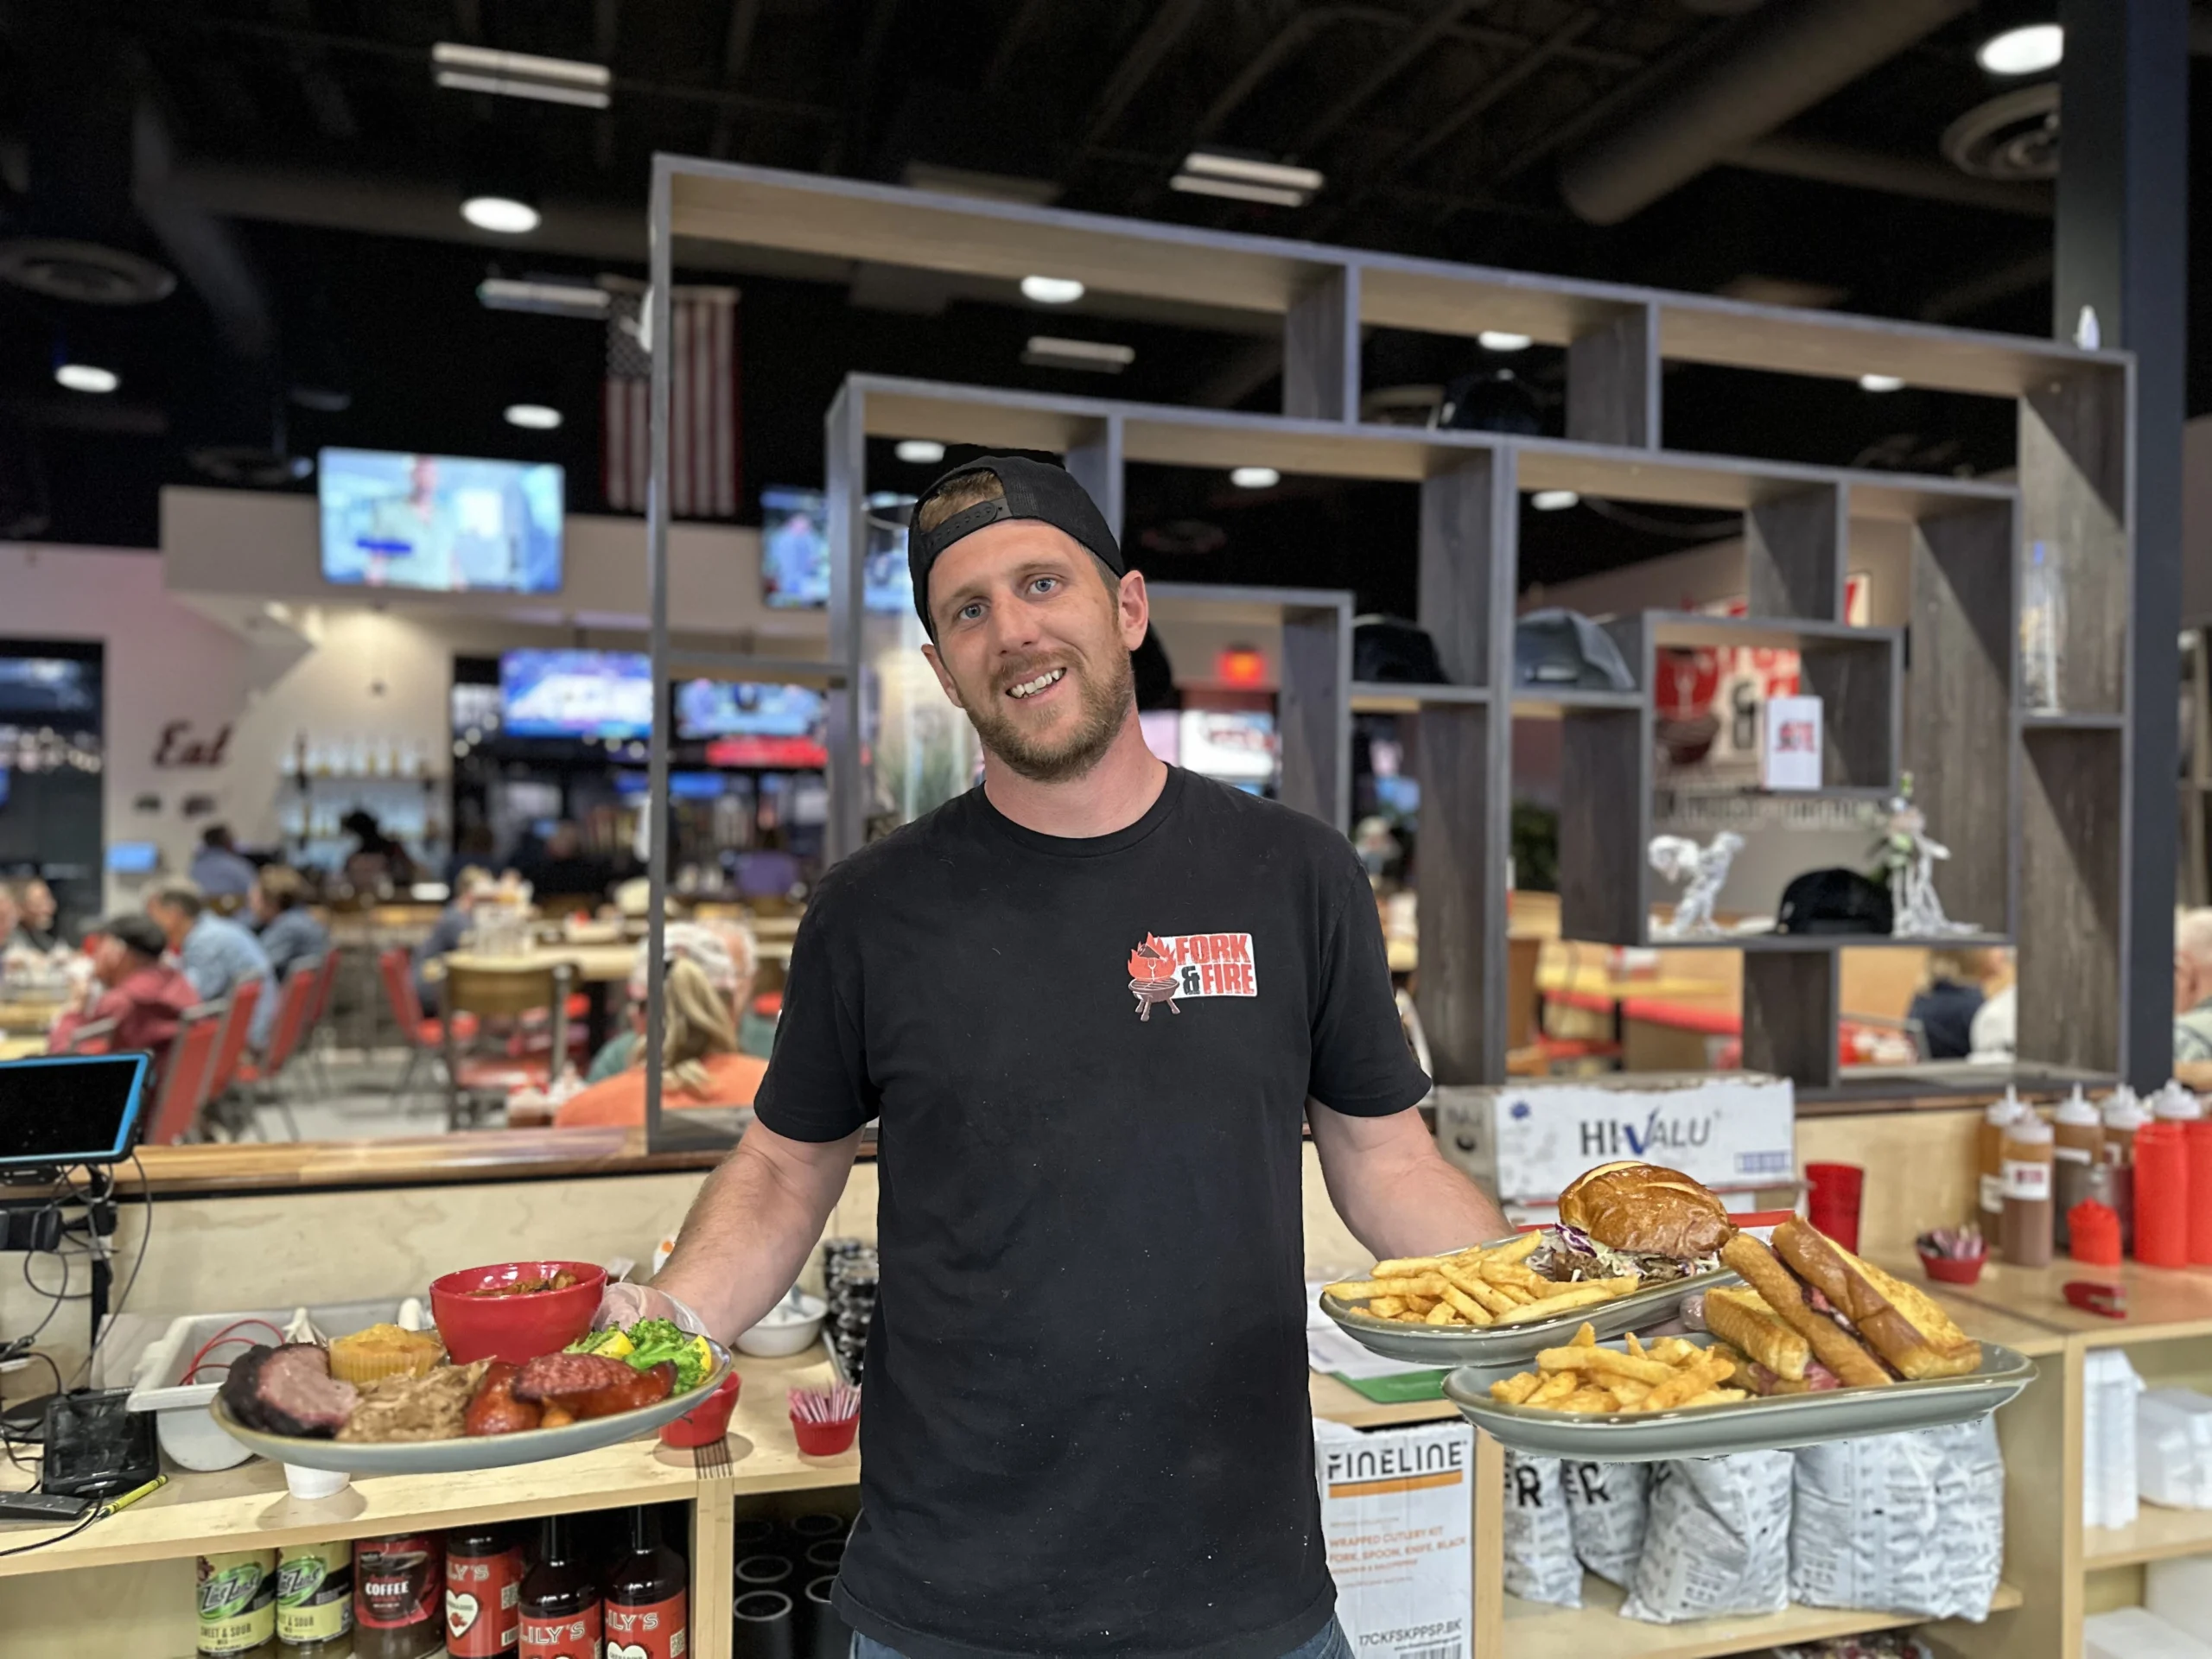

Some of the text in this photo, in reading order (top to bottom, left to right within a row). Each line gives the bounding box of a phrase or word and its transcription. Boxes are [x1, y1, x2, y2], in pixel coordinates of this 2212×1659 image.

[1175, 935, 1251, 965] FORK
[1182, 963, 1255, 995] & FIRE
[1580, 1107, 1710, 1155] HIVALU
[1328, 1440, 1462, 1479] FINELINE
[1329, 1534, 1382, 1548] WRAPPED
[1382, 1529, 1426, 1544] CUTLERY
[365, 1580, 410, 1596] COFFEE
[520, 1621, 586, 1644] LILY'S
[606, 1609, 659, 1631] ILY'S
